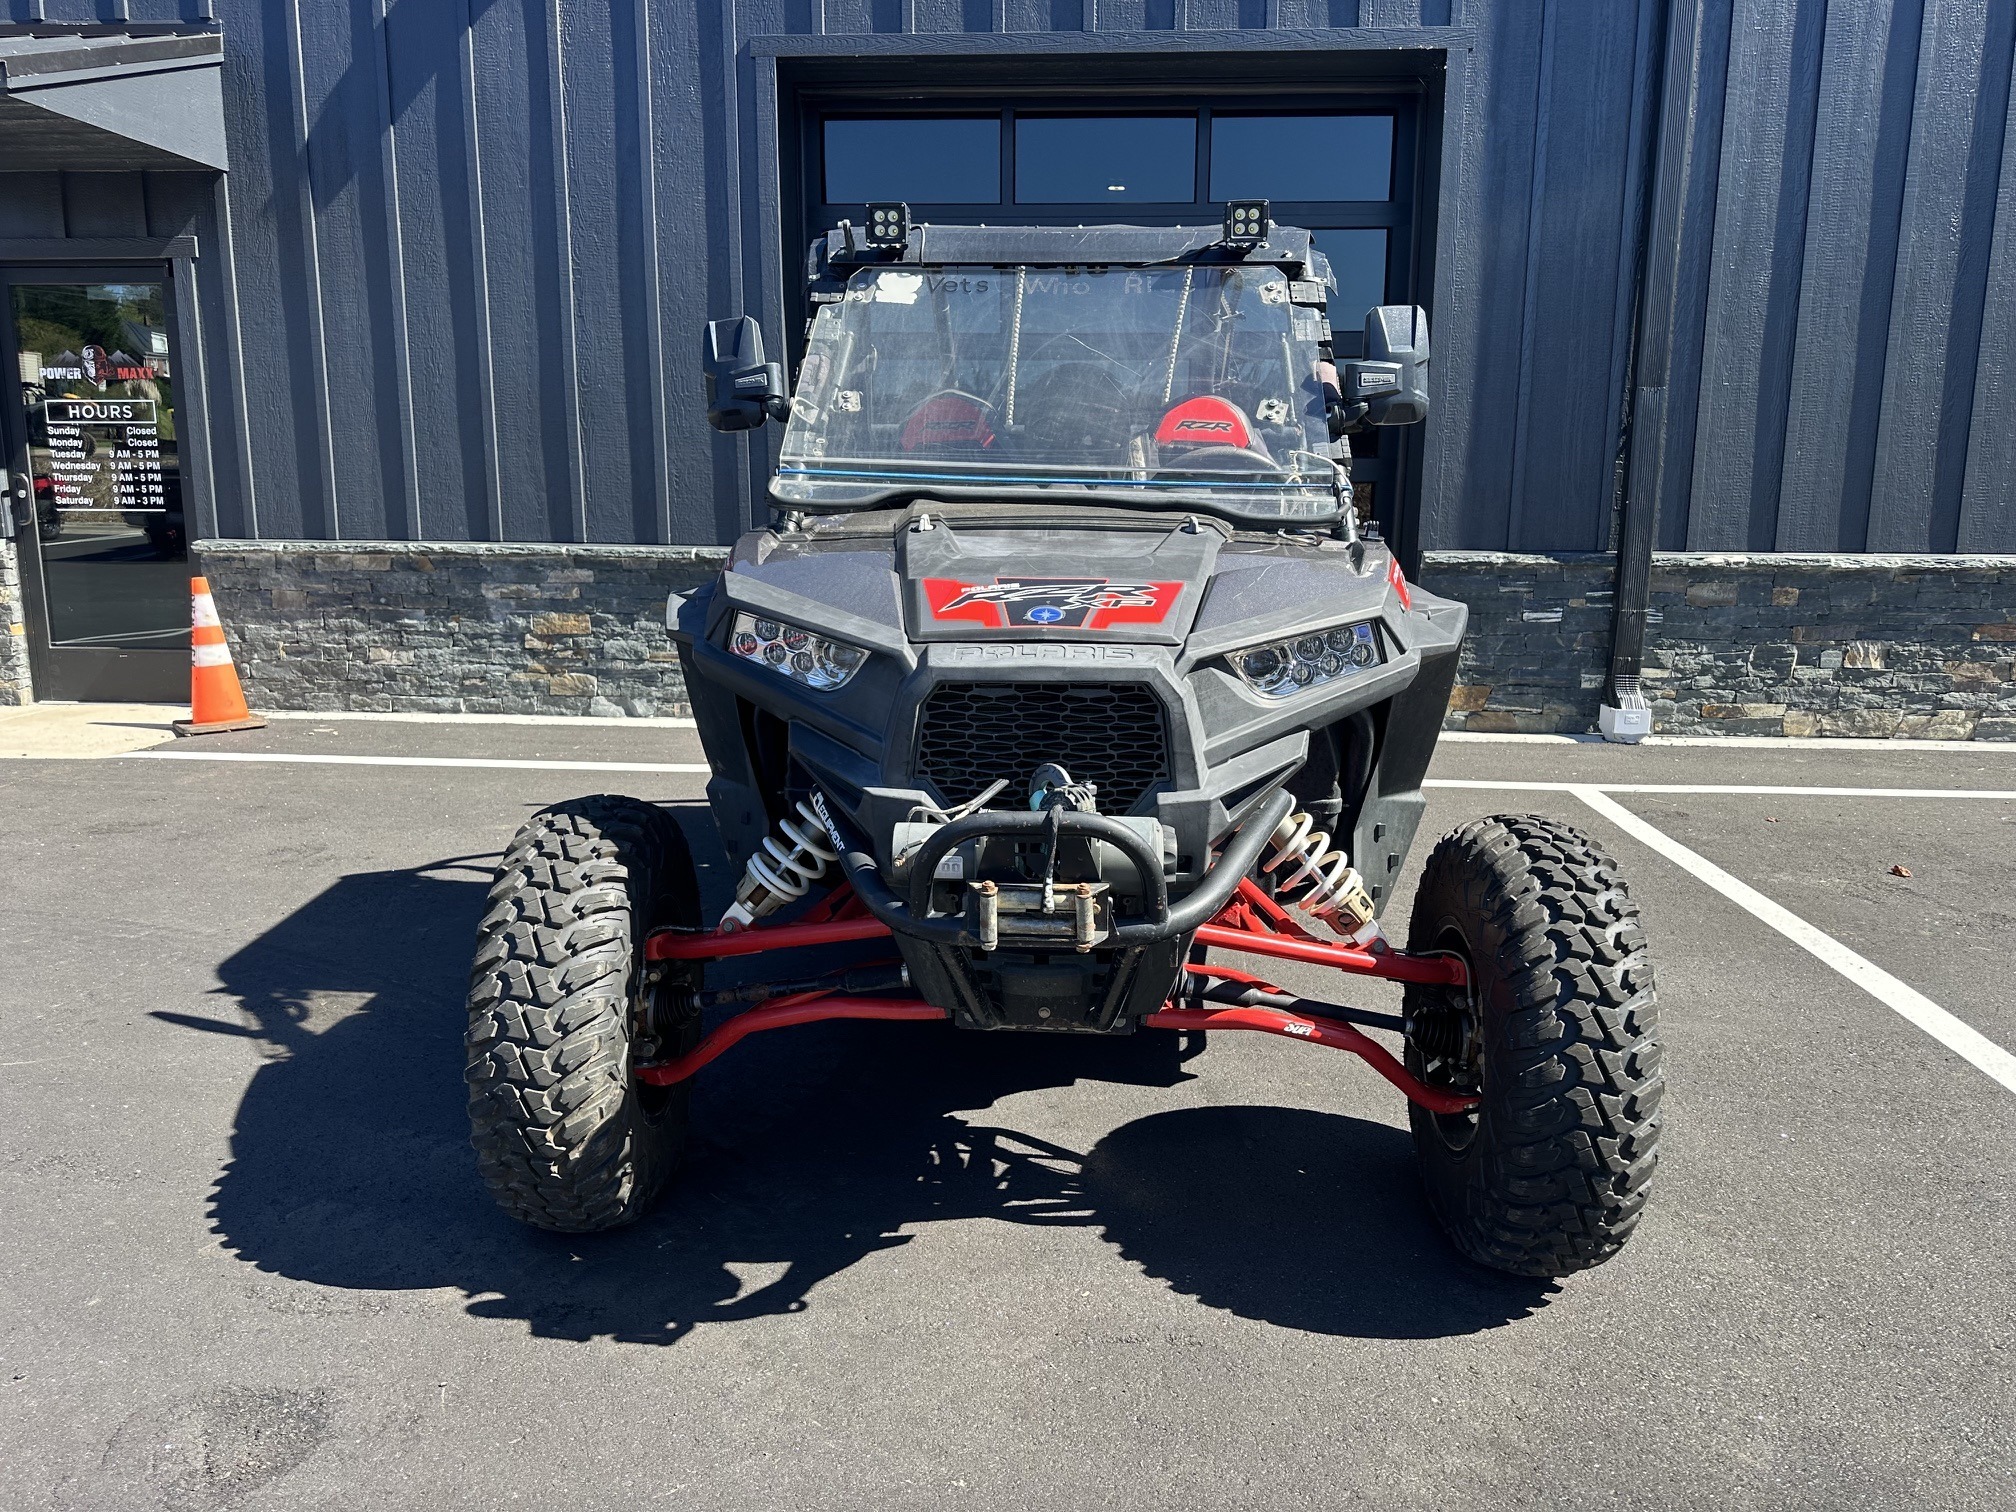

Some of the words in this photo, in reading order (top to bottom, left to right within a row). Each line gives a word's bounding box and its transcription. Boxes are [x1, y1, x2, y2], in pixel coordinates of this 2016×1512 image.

[926, 276, 989, 293] Vets
[1023, 277, 1090, 295] Who
[38, 367, 82, 380] POWER
[117, 367, 155, 380] MAXX
[68, 405, 133, 419] HOURS
[47, 426, 80, 437] Sunday
[126, 426, 157, 435] Closed
[1174, 420, 1234, 432] RZR
[49, 438, 83, 448] Monday
[127, 438, 158, 447] Closed
[51, 450, 86, 460] Tuesday
[109, 451, 114, 459] 9
[117, 451, 130, 459] AM
[138, 451, 143, 459] 5
[145, 451, 160, 459] PM
[51, 461, 101, 471] Wednesday
[110, 462, 115, 470] 9
[118, 462, 131, 470] AM
[139, 462, 144, 470] 5
[147, 462, 161, 470] PM
[53, 473, 93, 483] Thursday
[111, 474, 117, 482] 9
[119, 474, 132, 482] AM
[140, 474, 146, 482] 5
[148, 474, 162, 482] PM
[54, 484, 82, 494] Friday
[112, 485, 118, 493] 9
[120, 485, 134, 493] AM
[141, 485, 147, 493] 5
[149, 485, 163, 493] PM
[55, 496, 94, 506] Saturday
[114, 497, 119, 505] 9
[121, 497, 135, 505] AM
[142, 497, 148, 505] 3
[150, 497, 164, 505] PM
[961, 583, 1020, 592] POLARIS
[938, 584, 1160, 612] RZR
[1060, 598, 1157, 610] XP
[953, 644, 1135, 661] POLARIS
[819, 804, 846, 851] EQUIPMENT
